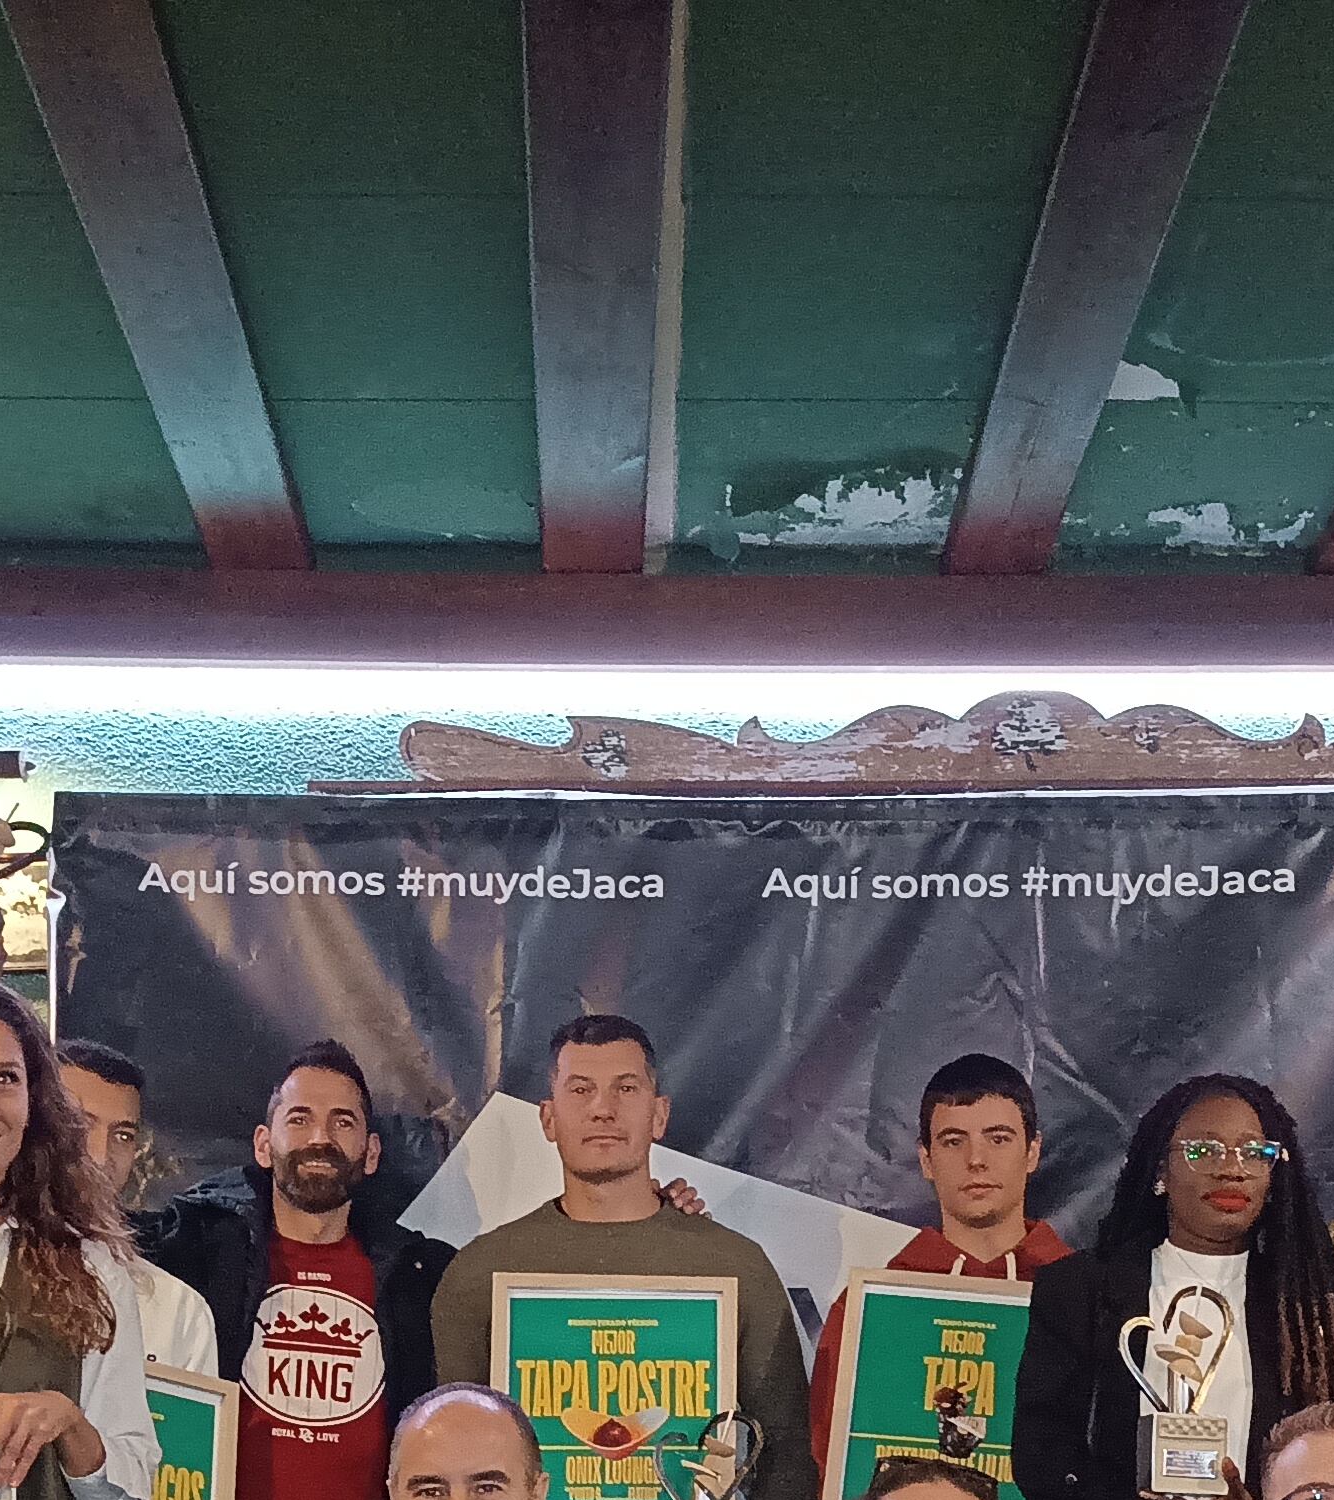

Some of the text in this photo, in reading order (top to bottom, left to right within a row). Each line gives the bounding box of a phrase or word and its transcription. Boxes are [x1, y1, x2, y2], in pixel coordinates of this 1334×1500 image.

[137, 861, 665, 905] Aquí somos #muydeJaca
[762, 864, 1296, 907] Aquí somos #muydeJaca
[591, 1330, 636, 1355] MEJOR
[268, 1356, 354, 1404] KING
[516, 1360, 711, 1418] TAPA POSTRE
[566, 1456, 602, 1485] ONIX
